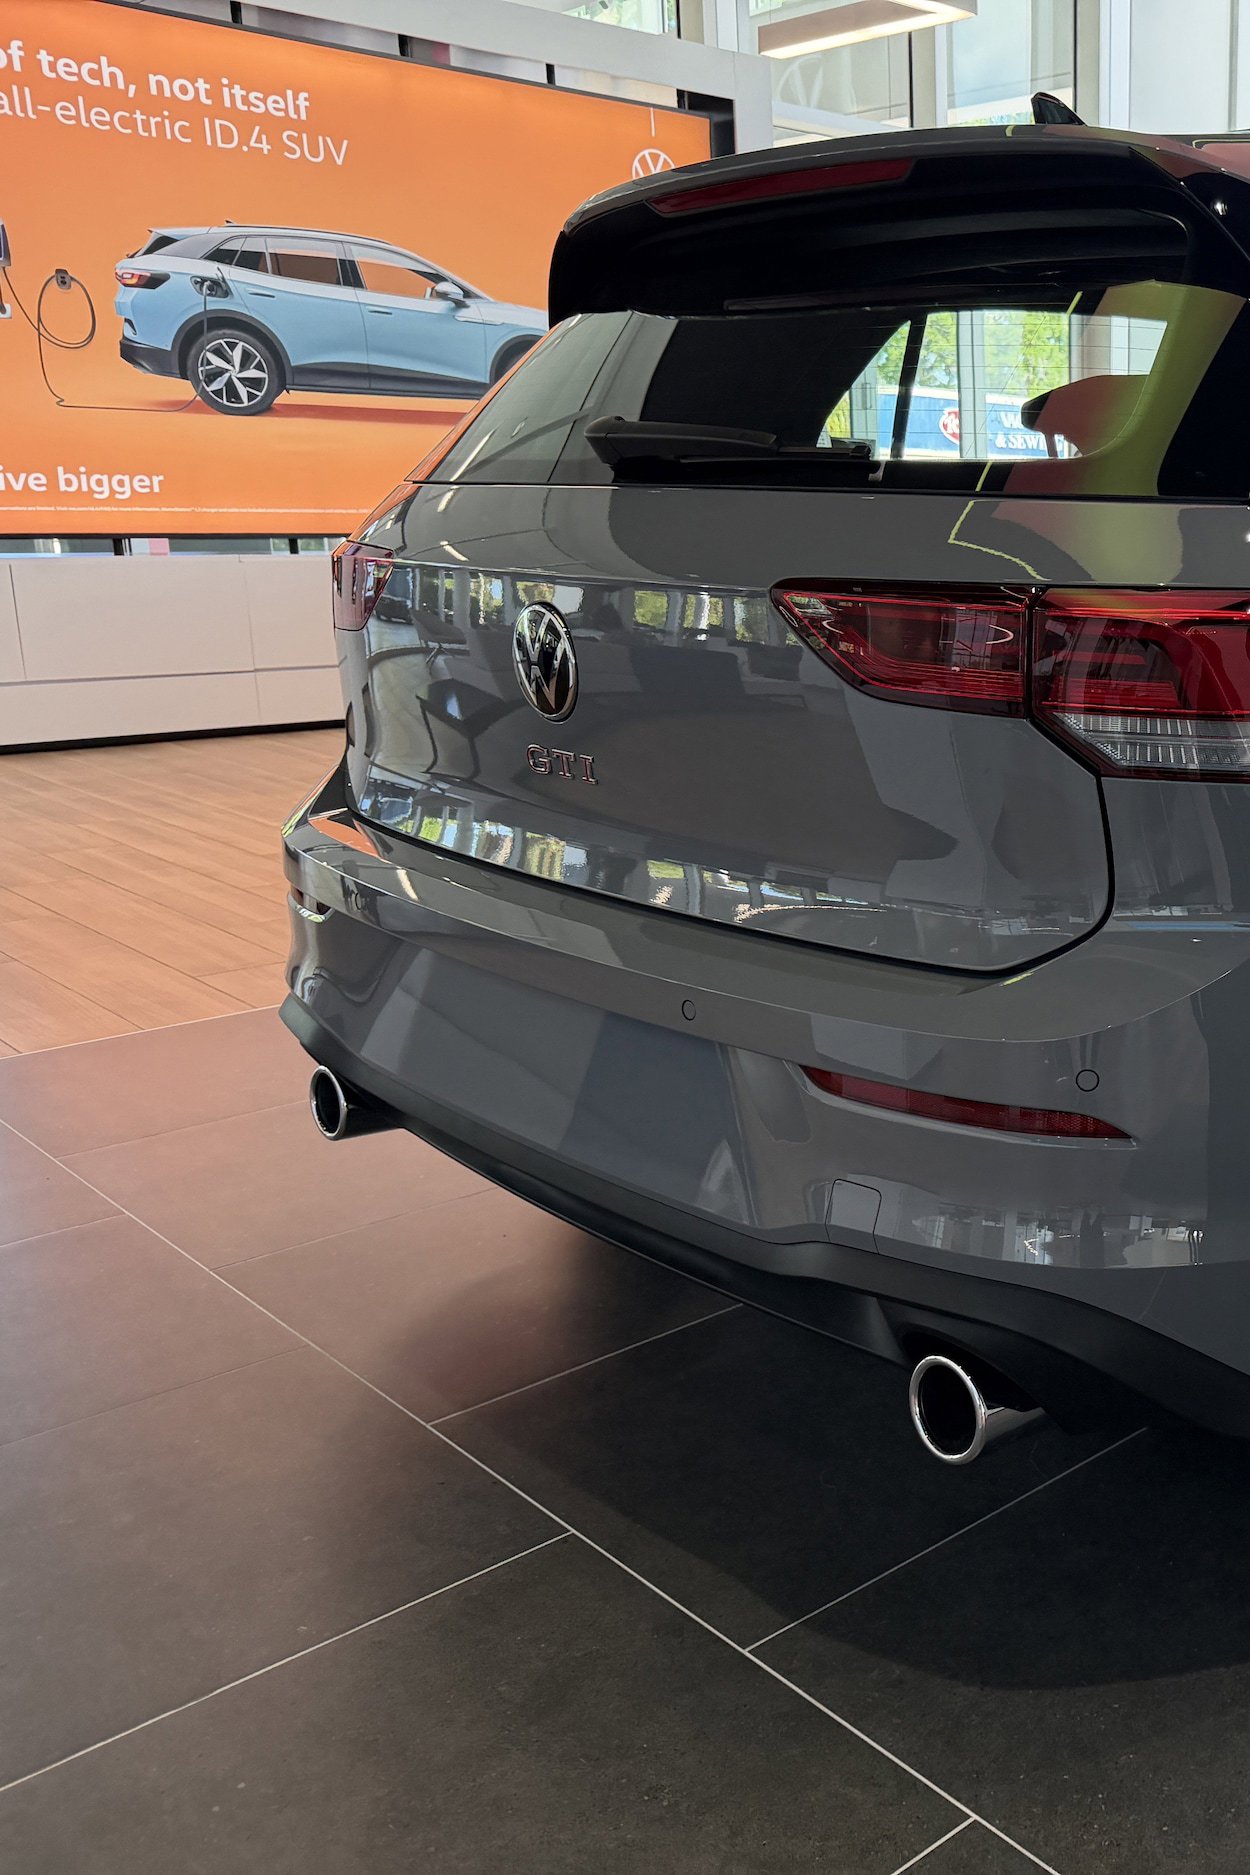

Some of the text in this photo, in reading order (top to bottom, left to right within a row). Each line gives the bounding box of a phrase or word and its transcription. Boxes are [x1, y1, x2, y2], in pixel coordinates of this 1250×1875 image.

[36, 49, 136, 98] tech,
[148, 73, 212, 105] not
[221, 77, 310, 120] itself
[0, 84, 349, 165] all-electric ID.4 SUV
[57, 466, 164, 499] bigger
[527, 743, 599, 785] GTI
